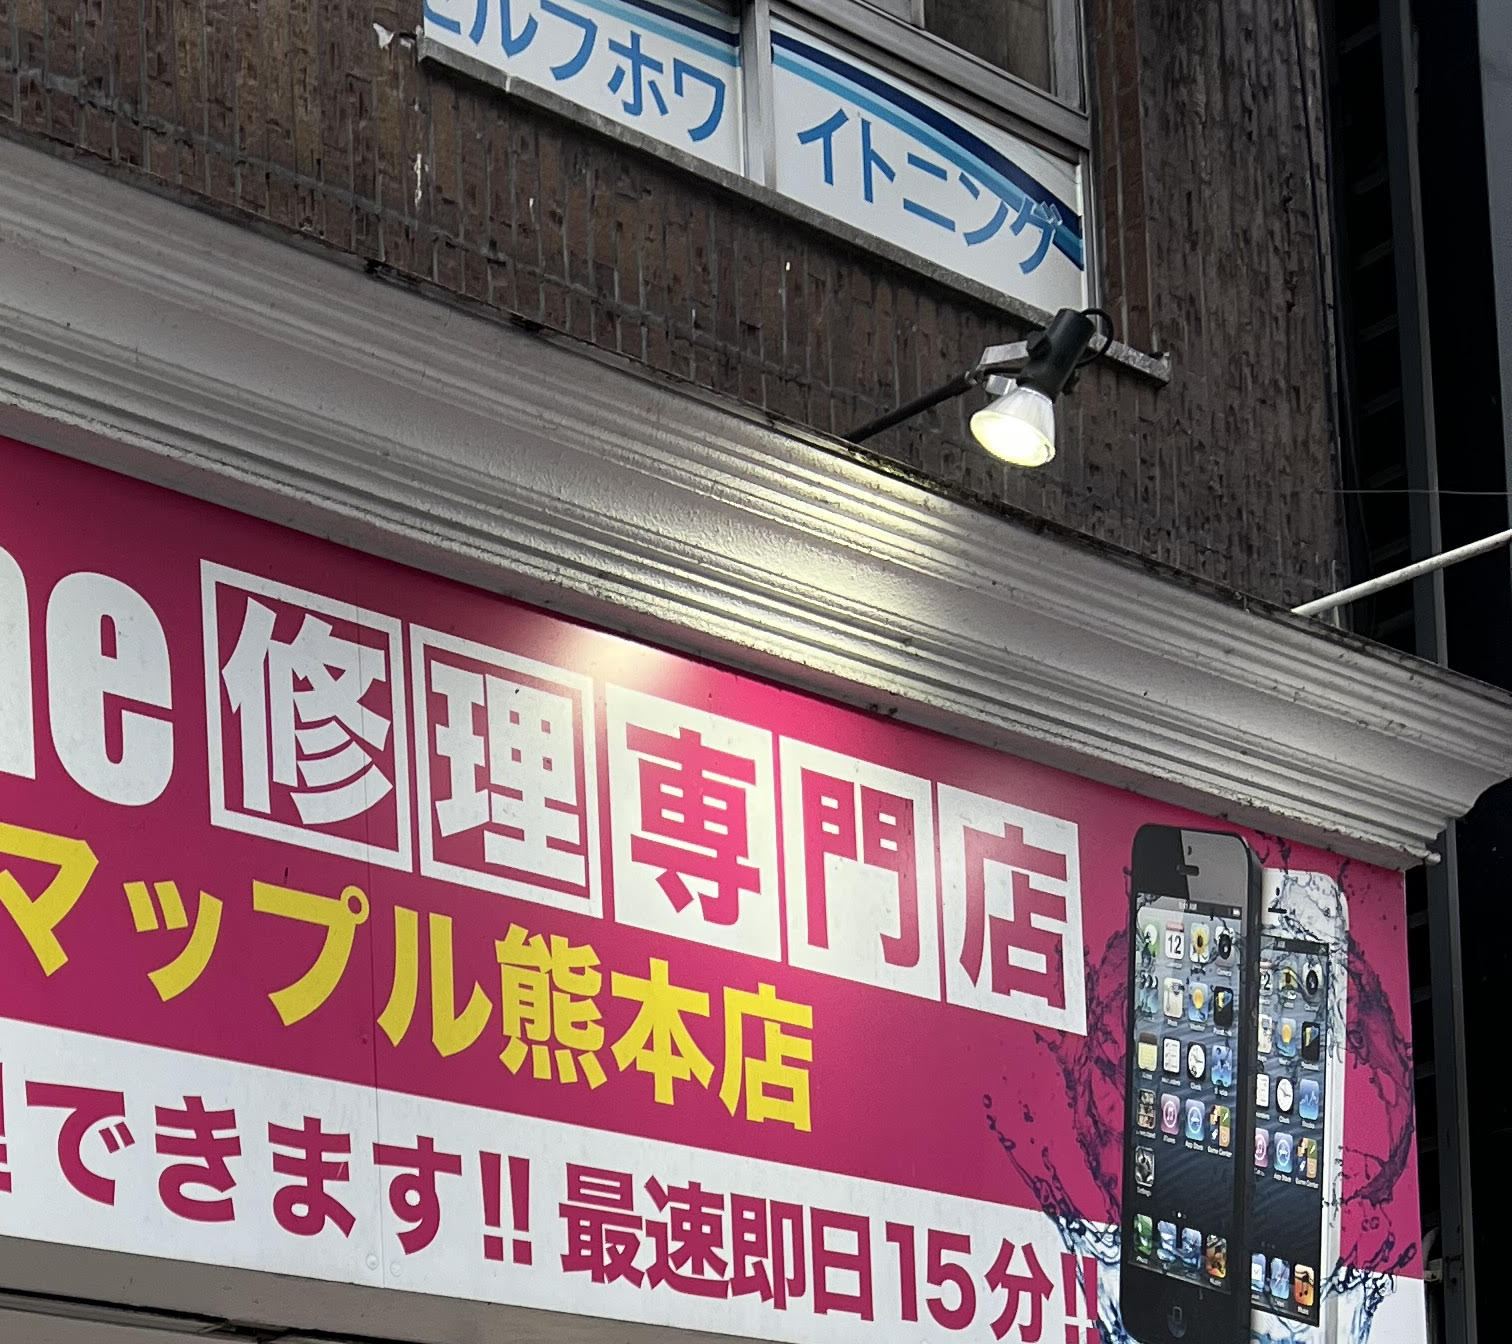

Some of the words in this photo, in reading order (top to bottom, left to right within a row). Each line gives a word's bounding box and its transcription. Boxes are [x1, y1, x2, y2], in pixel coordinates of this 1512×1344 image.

[797, 108, 1063, 274] イトニング
[204, 562, 1085, 1032] 修理専門店
[1168, 934, 1182, 955] 12
